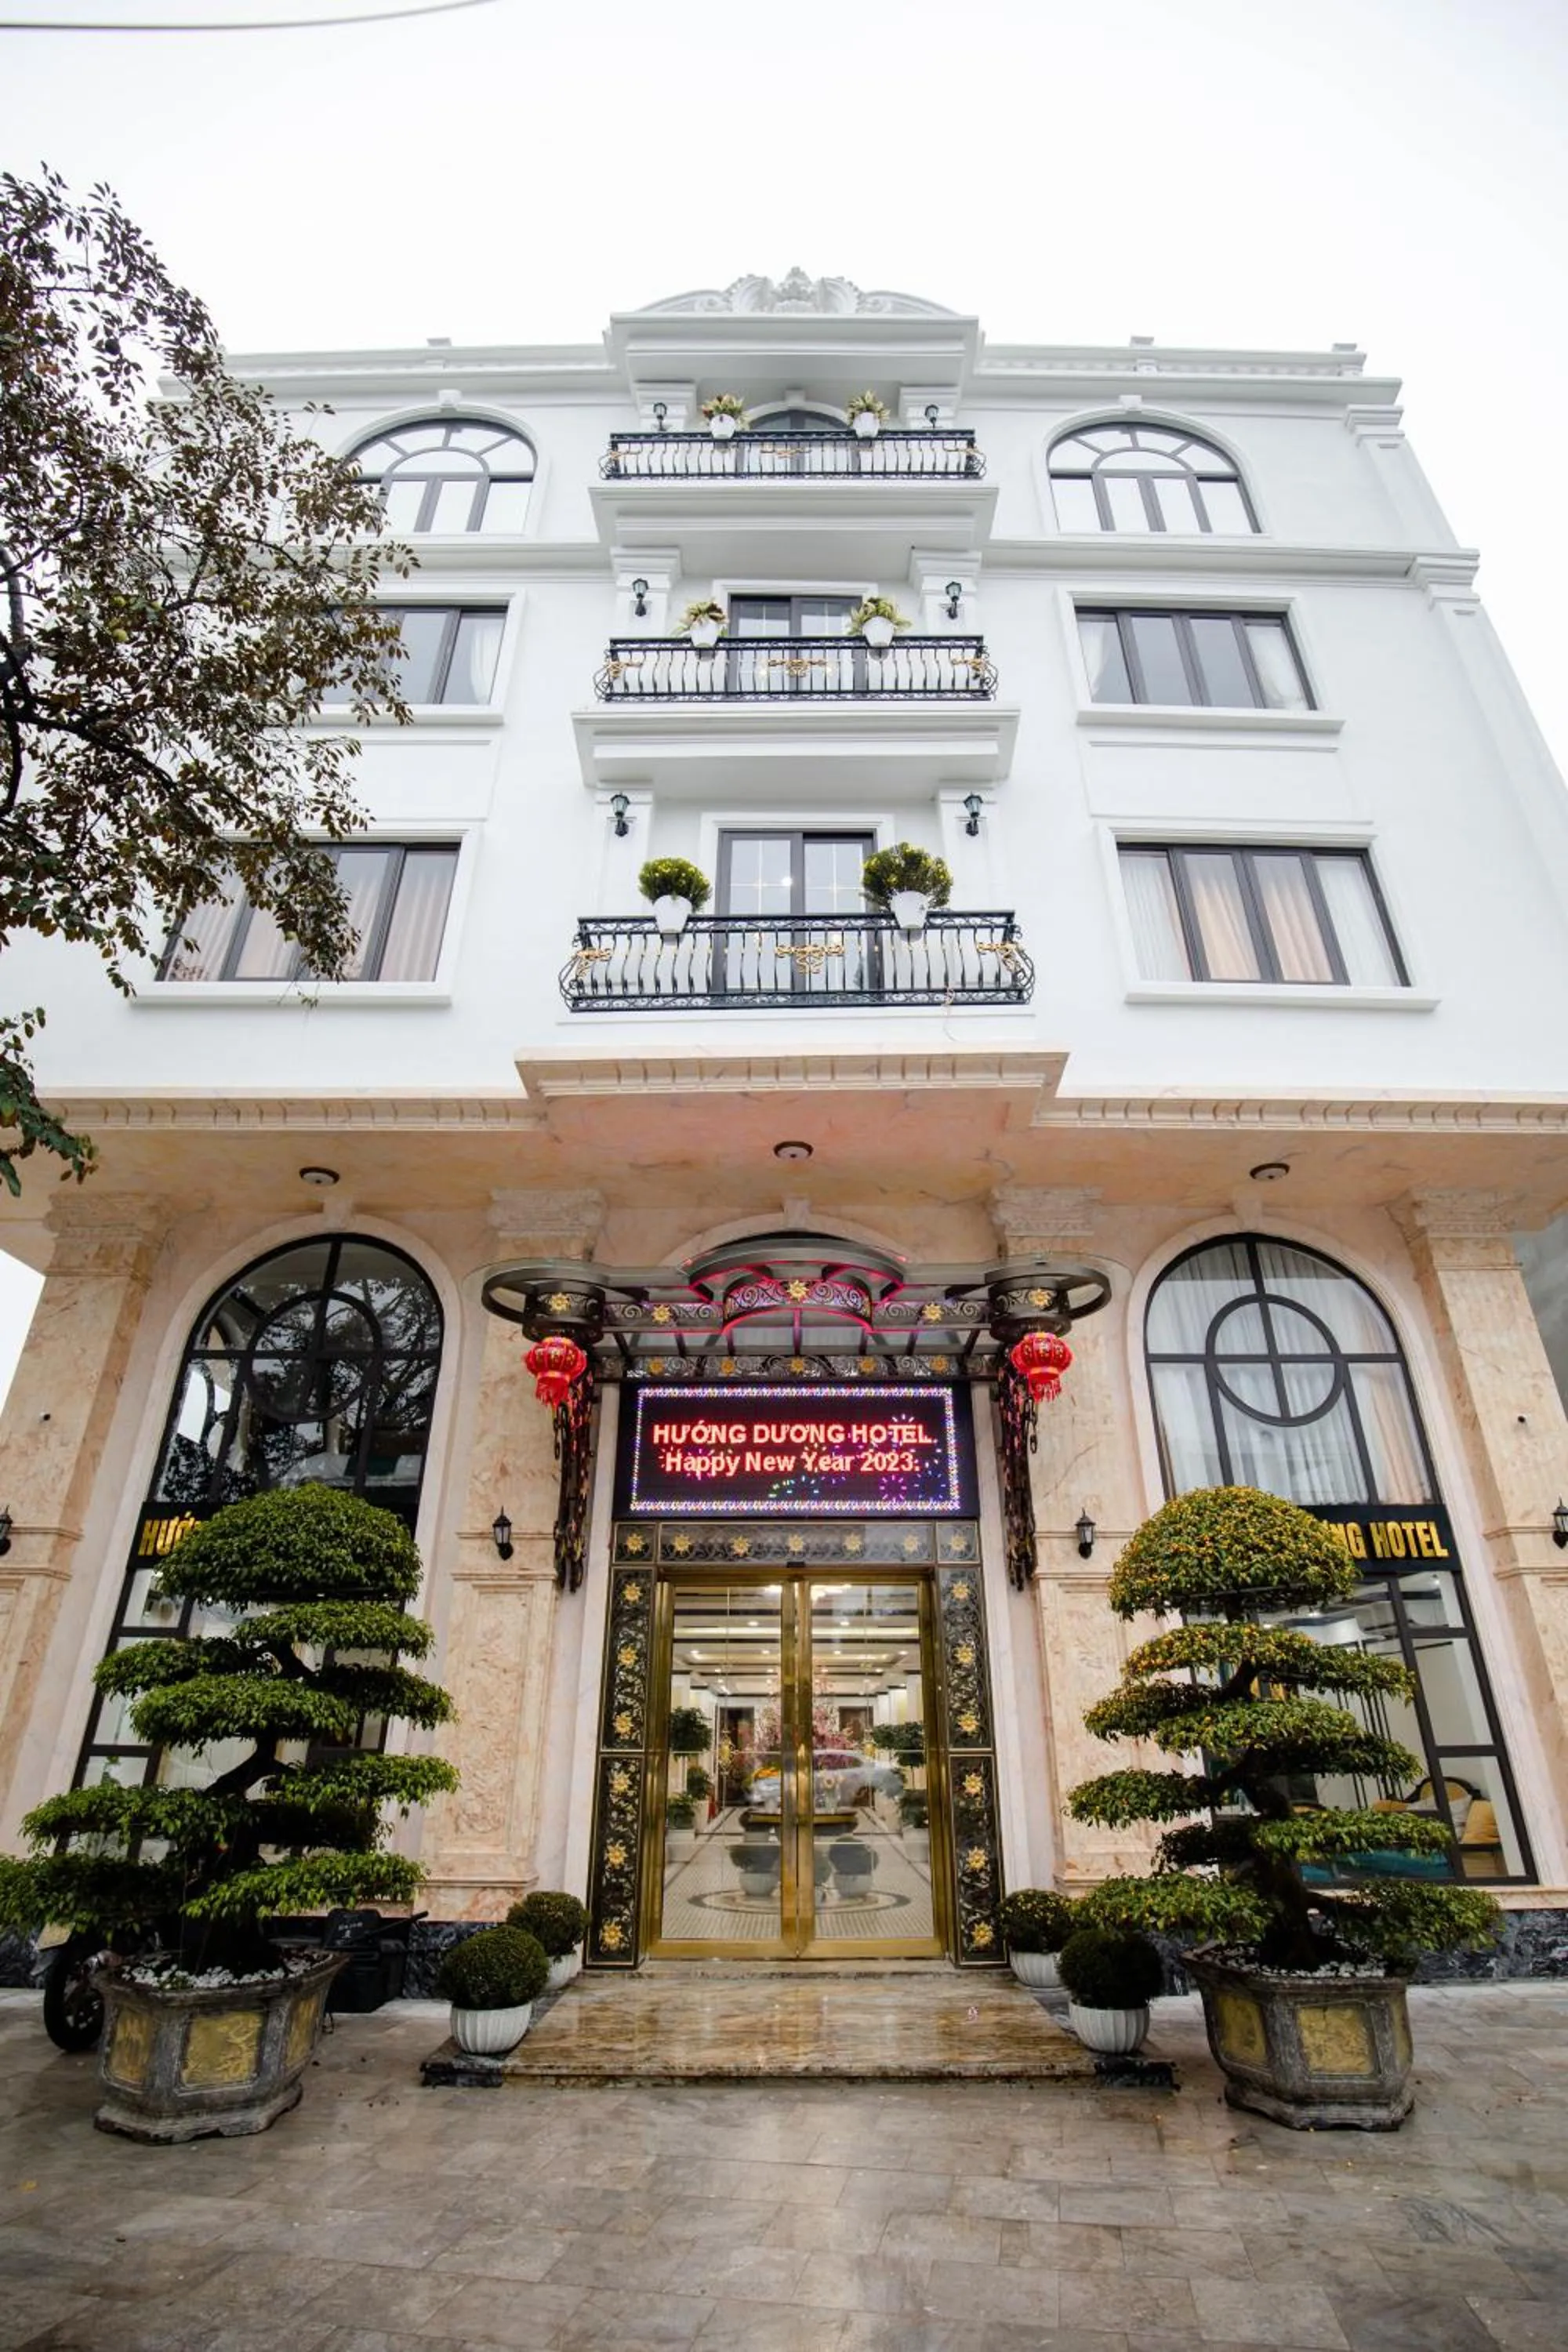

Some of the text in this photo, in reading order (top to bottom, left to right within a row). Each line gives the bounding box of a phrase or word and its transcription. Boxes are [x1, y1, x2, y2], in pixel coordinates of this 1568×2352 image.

[666, 1451, 741, 1477] Happy
[745, 1451, 797, 1472] New
[801, 1451, 855, 1472] Year
[1370, 1521, 1450, 1558] HOTEL
